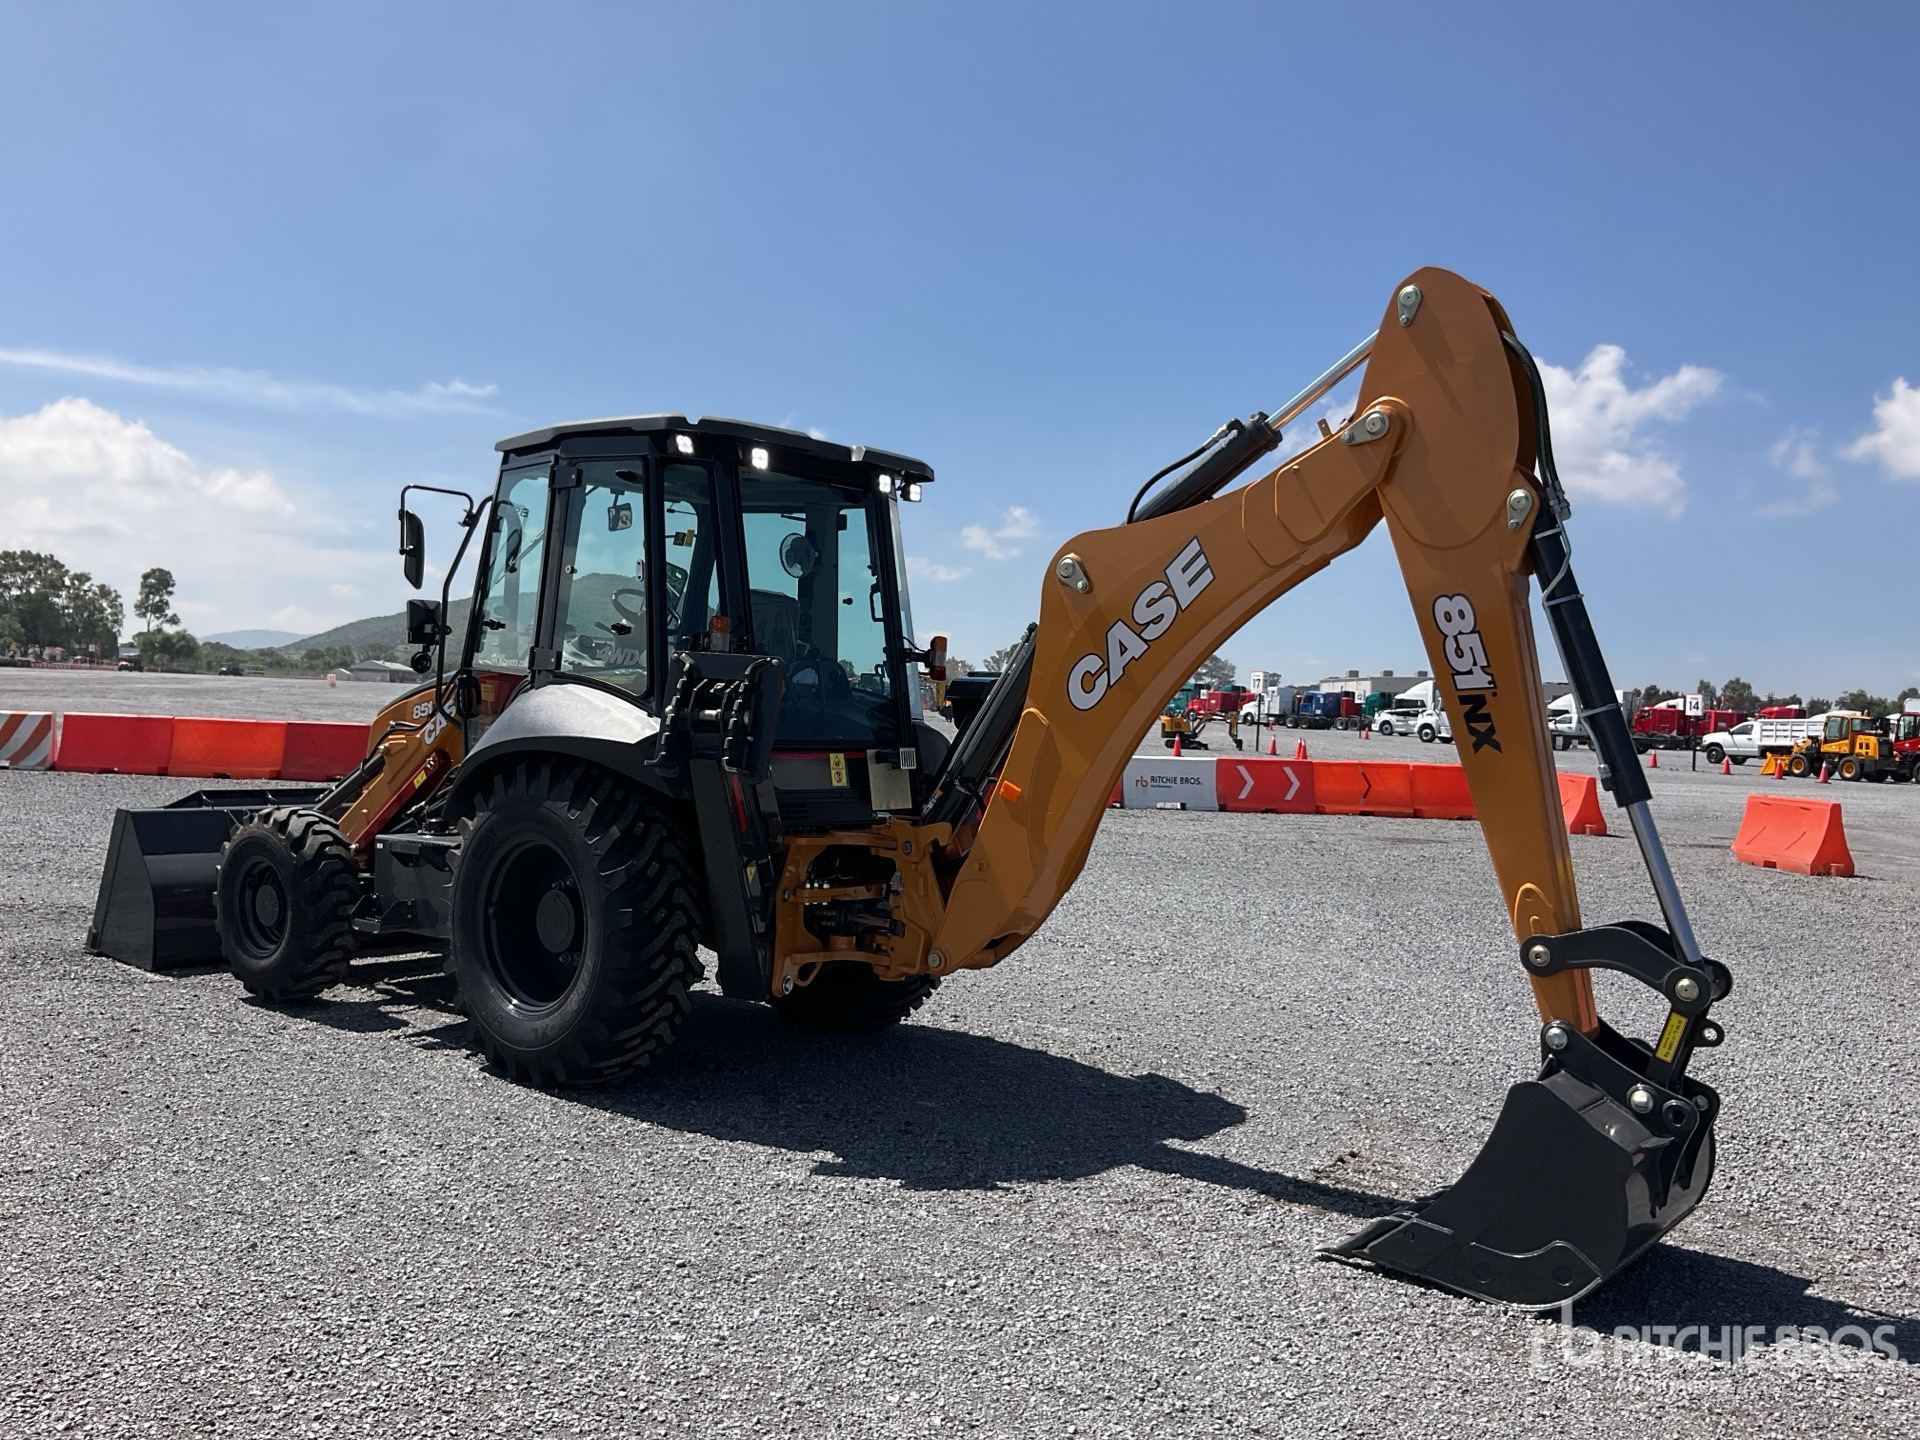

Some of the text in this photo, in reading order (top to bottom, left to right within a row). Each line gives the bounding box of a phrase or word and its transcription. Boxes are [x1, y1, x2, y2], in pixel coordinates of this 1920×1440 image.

[1066, 535, 1216, 711] CASE
[596, 645, 640, 665] 4WD
[1252, 678, 1261, 689] 17
[1688, 700, 1700, 711] 14
[1150, 775, 1178, 785] RITCHIE
[1179, 776, 1203, 786] BROS.
